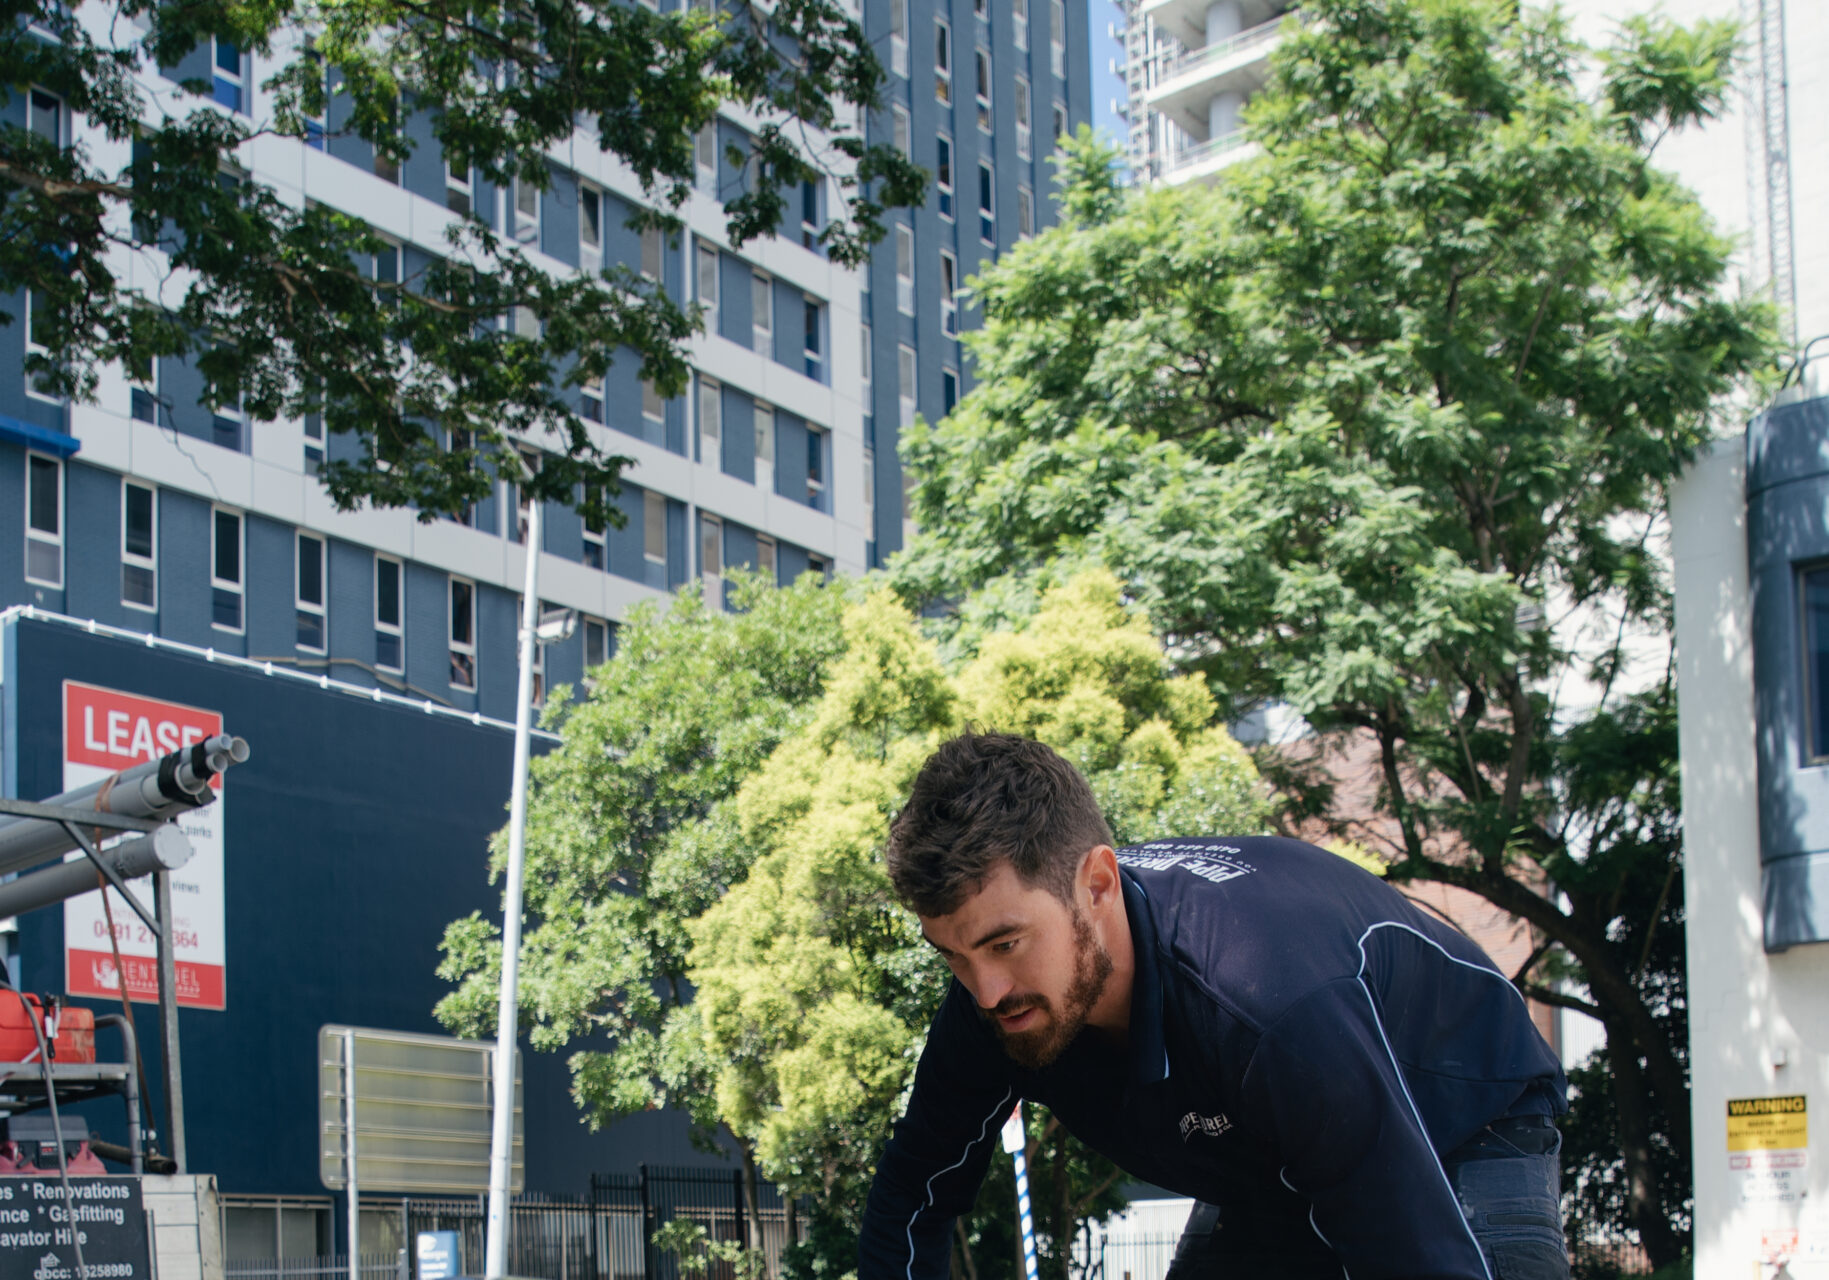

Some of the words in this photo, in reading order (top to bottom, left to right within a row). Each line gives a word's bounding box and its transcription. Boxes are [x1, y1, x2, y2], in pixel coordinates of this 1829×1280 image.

[1178, 859, 1246, 883] PIPE
[94, 920, 130, 942] 091
[121, 959, 199, 987] SENTNEL
[1729, 1097, 1804, 1115] WARNING
[33, 1181, 130, 1199] Renovations
[49, 1204, 124, 1225] Gasfitting
[55, 1228, 87, 1245] Hie
